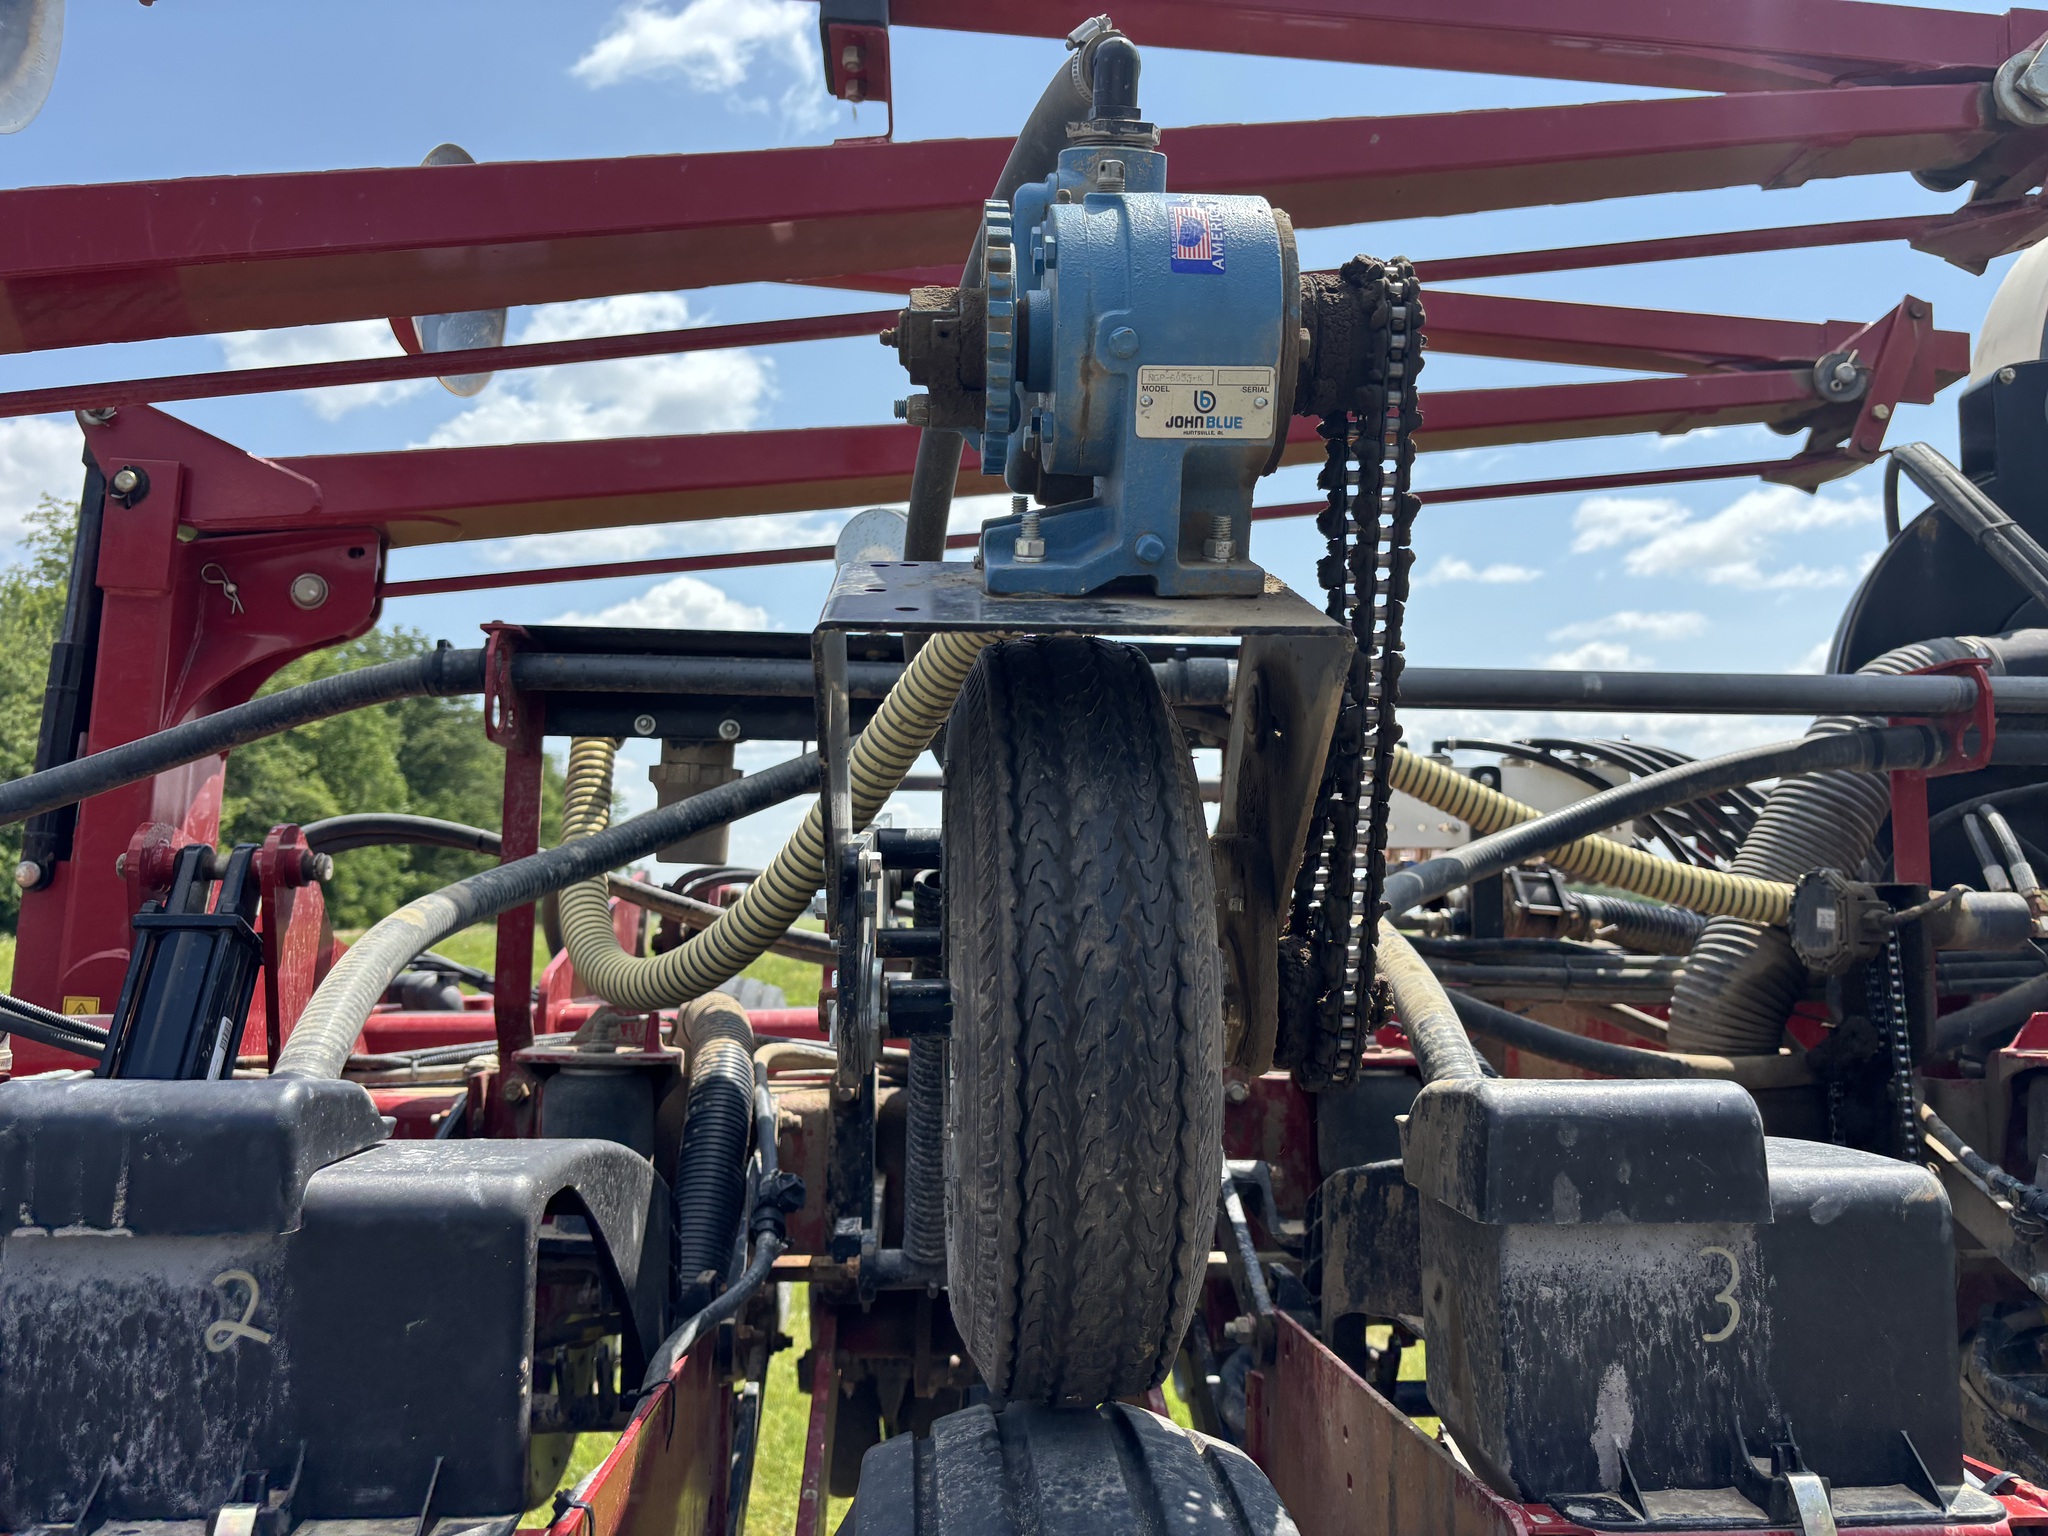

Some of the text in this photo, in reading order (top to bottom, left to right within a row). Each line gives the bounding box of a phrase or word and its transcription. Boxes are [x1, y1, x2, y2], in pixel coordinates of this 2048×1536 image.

[1169, 213, 1178, 260] ASSEMBLED
[1165, 416, 1243, 429] JOHN BLUE
[204, 1268, 272, 1352] 2
[1699, 1246, 1741, 1342] 3
